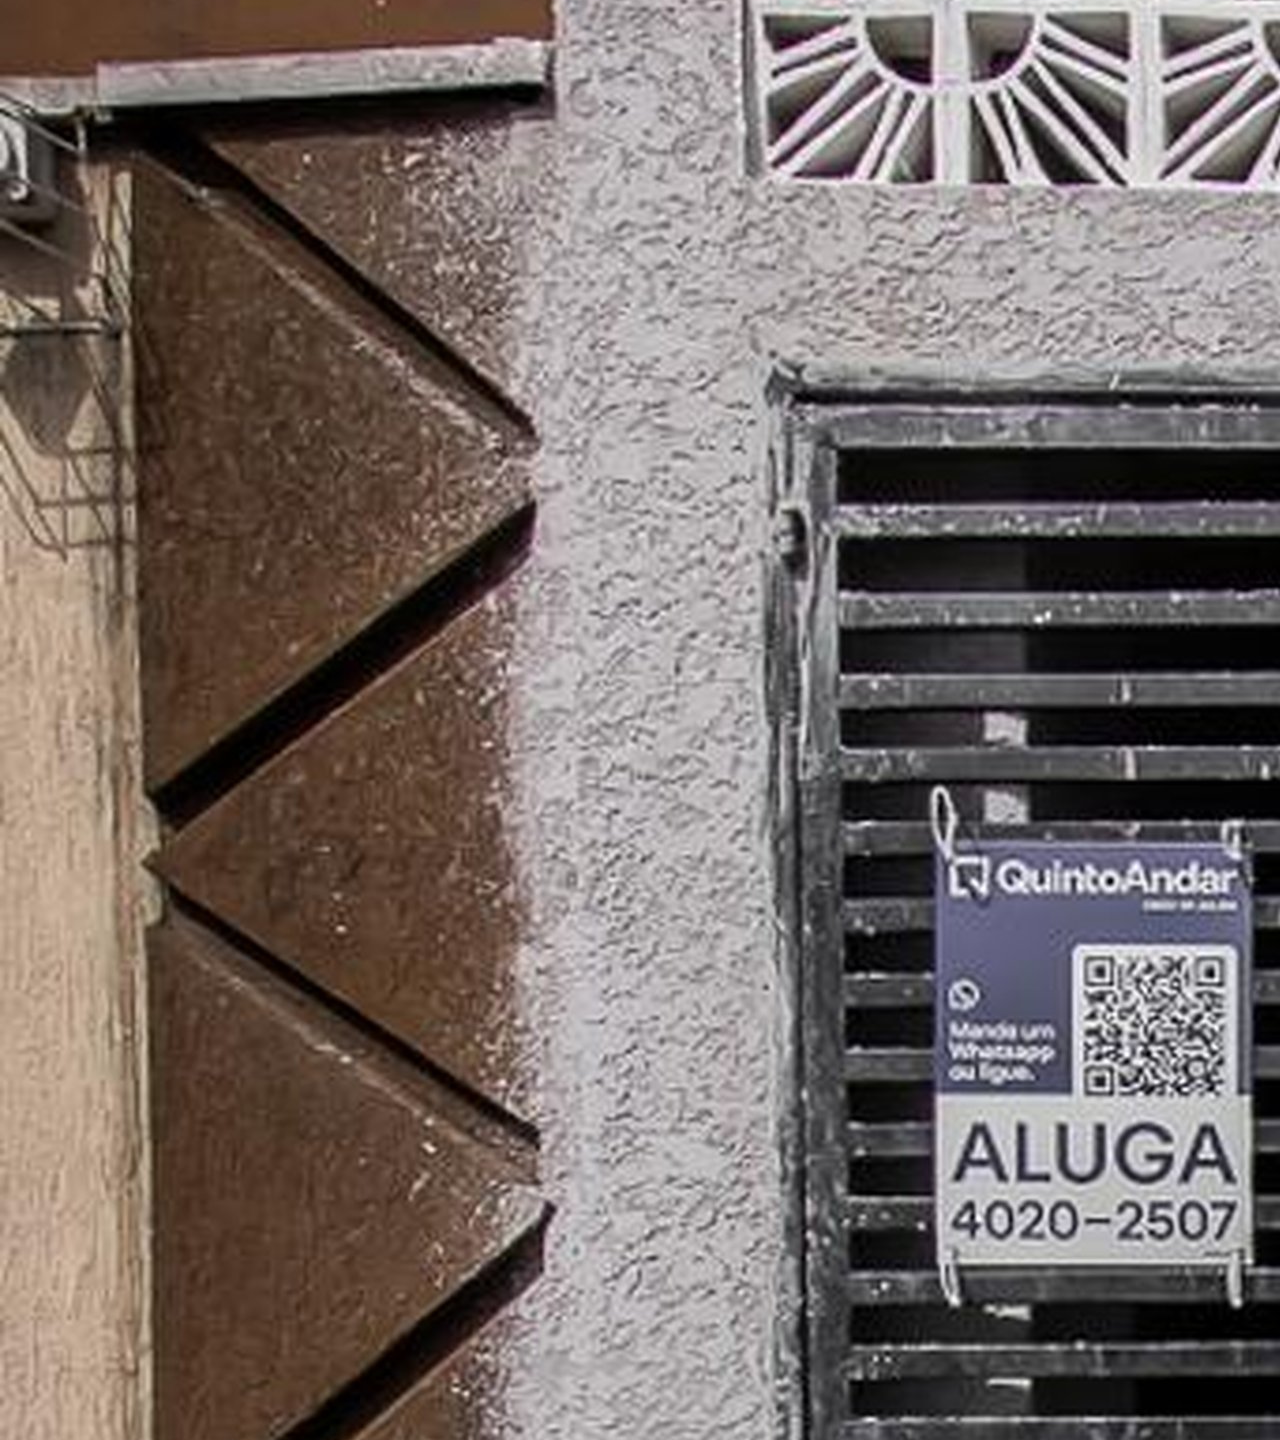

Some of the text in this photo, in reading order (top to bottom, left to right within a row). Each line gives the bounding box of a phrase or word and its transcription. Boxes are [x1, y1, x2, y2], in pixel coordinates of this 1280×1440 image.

[997, 860, 1238, 894] QuintoAndar
[949, 1021, 1056, 1040] Manda um
[948, 1064, 976, 1081] ou
[953, 1121, 1237, 1184] ALUGA
[951, 1199, 1238, 1241] 4020-2507
